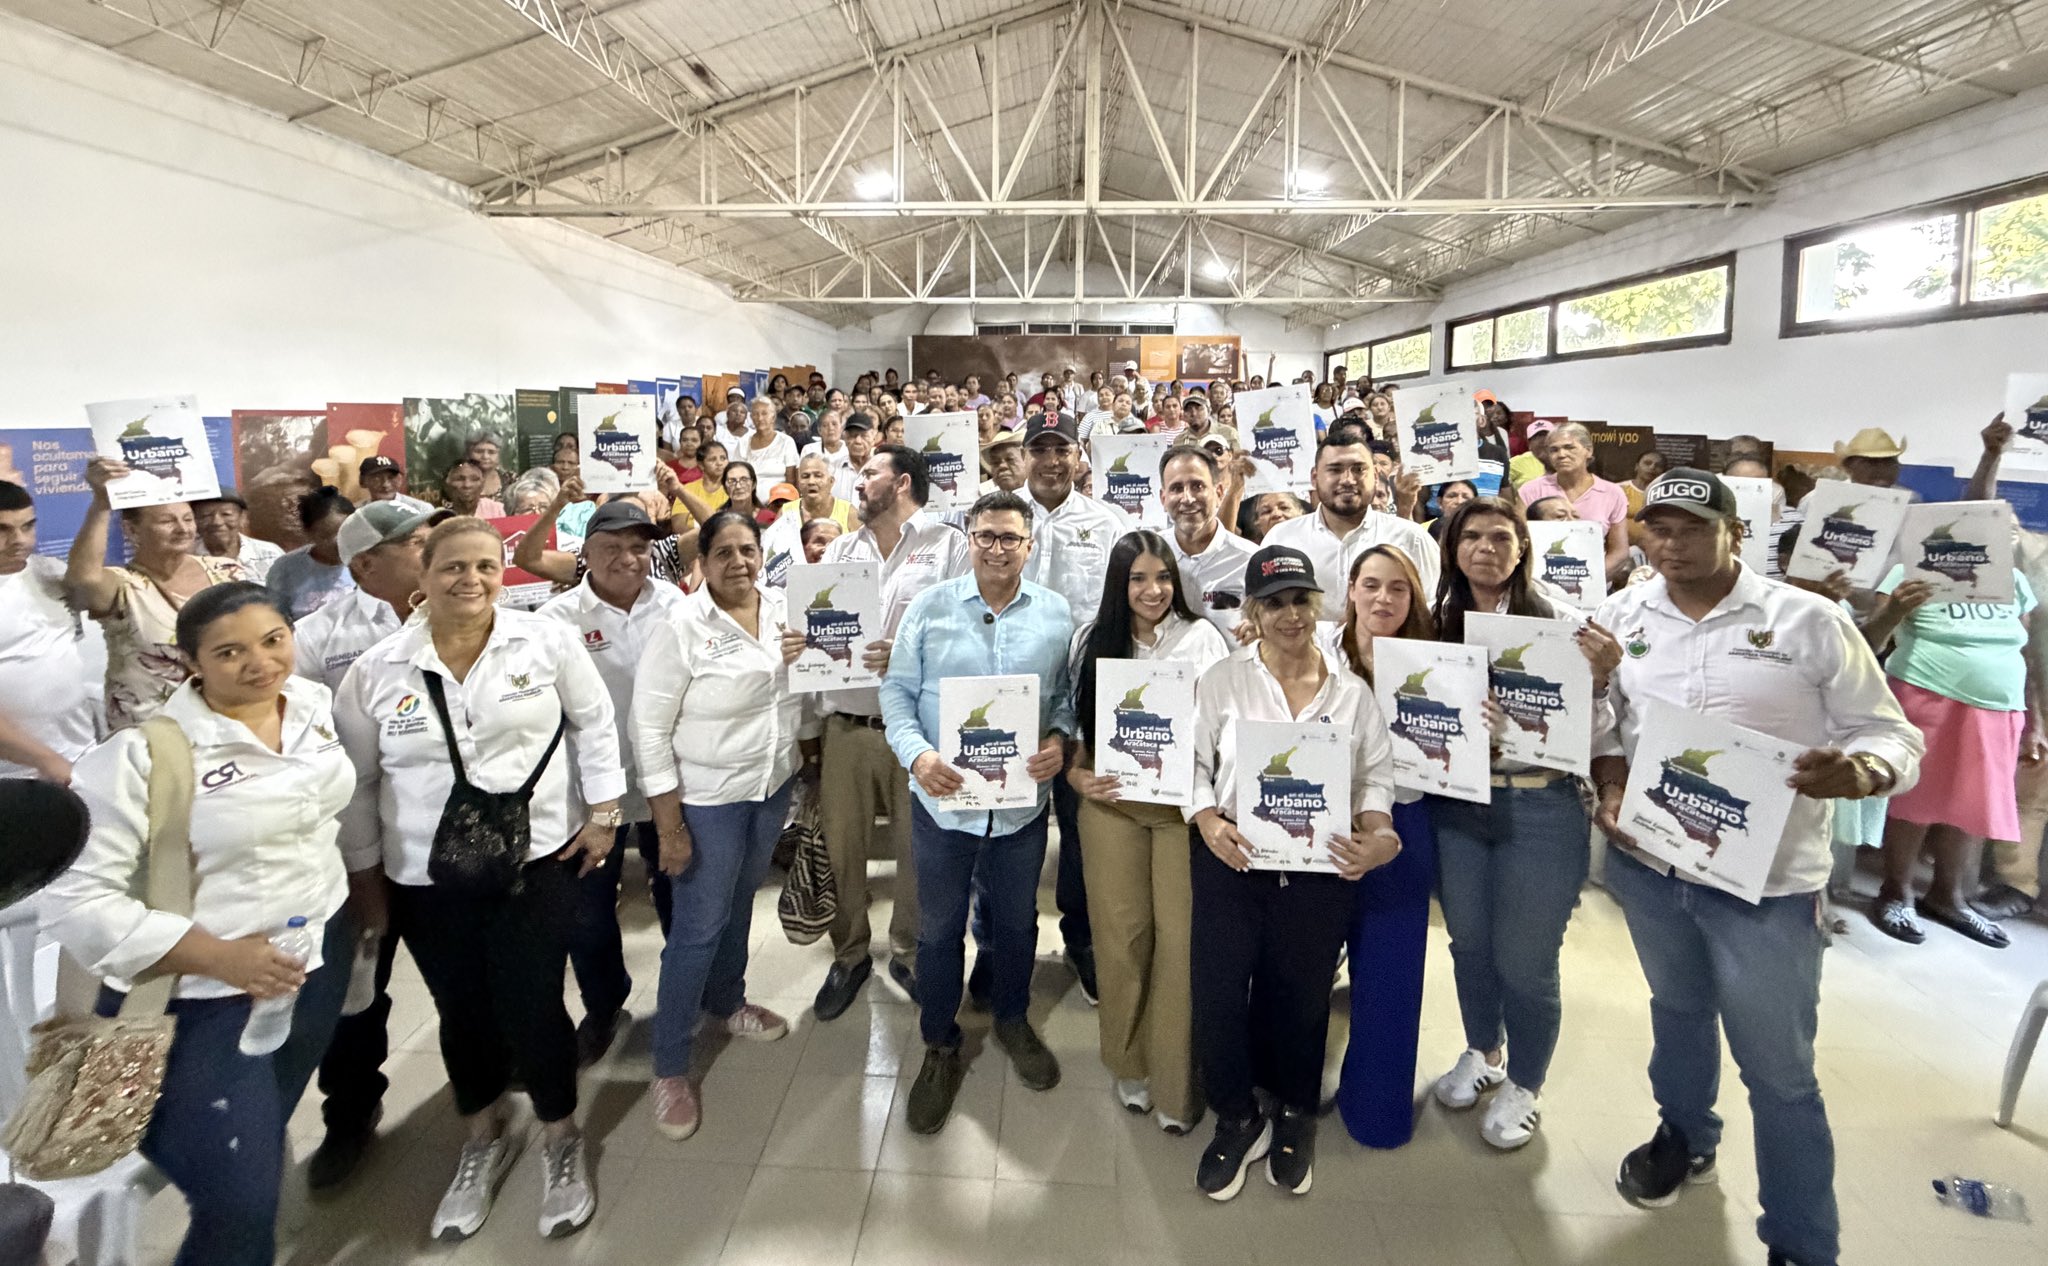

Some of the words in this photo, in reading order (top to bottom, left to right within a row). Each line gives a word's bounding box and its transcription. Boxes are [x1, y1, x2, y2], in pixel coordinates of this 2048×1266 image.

[1043, 412, 1058, 427] B
[1258, 440, 1296, 450] Urbano
[1418, 434, 1458, 444] Urbano
[32, 440, 60, 451] Nos
[598, 443, 638, 452] Urbano
[33, 450, 97, 462] ocultamo
[127, 448, 184, 459] Urbano
[34, 463, 68, 475] para
[34, 473, 78, 486] seguir
[1110, 485, 1149, 494] Urbano
[1650, 483, 1706, 501] HUGO
[1823, 531, 1870, 546] Urbano
[1928, 553, 1985, 562] Urbano
[1548, 566, 1587, 575] Urbano
[1949, 603, 2008, 619] DIOS
[811, 625, 858, 636] Urbano
[1494, 686, 1559, 706] Urbano
[1400, 712, 1459, 732] Urbano
[1120, 726, 1170, 741] Urbano
[964, 745, 1014, 756] Urbano
[1264, 794, 1322, 808] Urbano
[1663, 782, 1741, 824] Urbano
